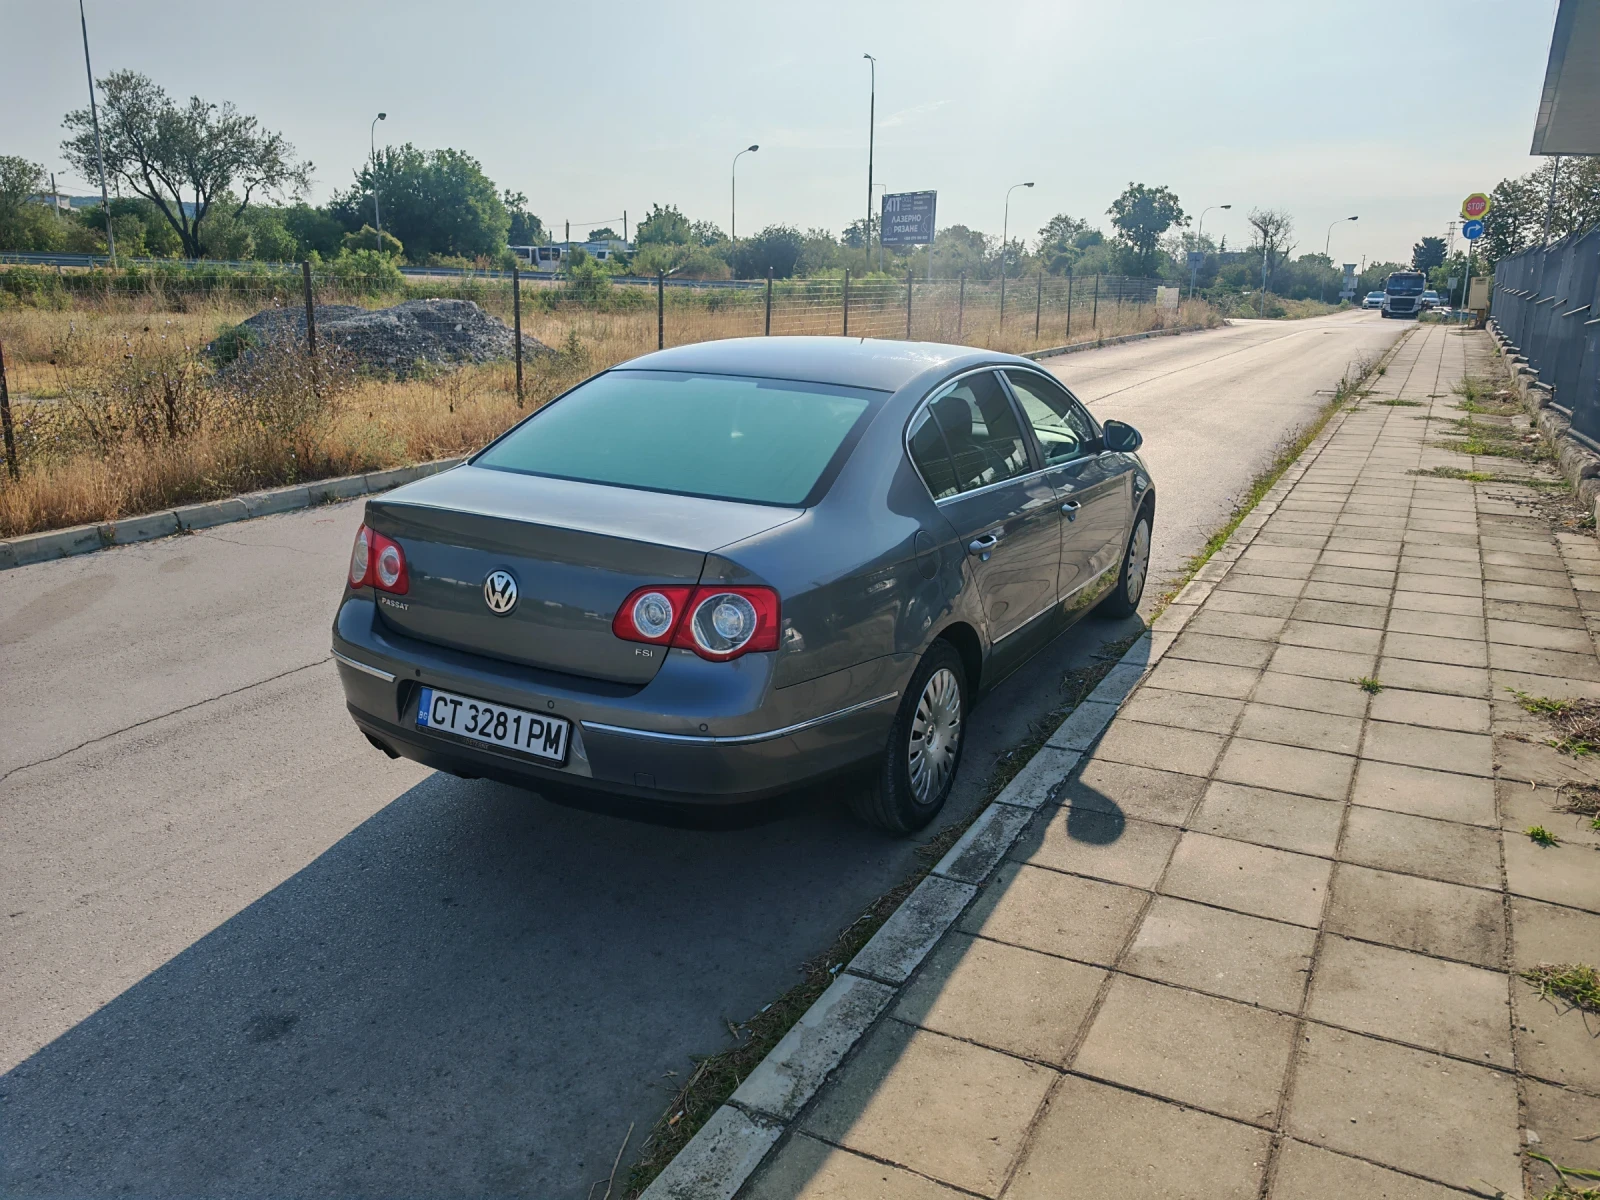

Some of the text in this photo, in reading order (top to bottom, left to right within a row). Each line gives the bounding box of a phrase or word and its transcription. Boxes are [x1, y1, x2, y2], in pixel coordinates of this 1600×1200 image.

[1467, 202, 1485, 211] STOP
[892, 214, 921, 224] ЛАЗЕРНО
[894, 225, 918, 233] РЯЗАНЕ
[381, 597, 409, 611] PASSAT
[635, 648, 653, 657] FSI
[418, 711, 428, 720] BG
